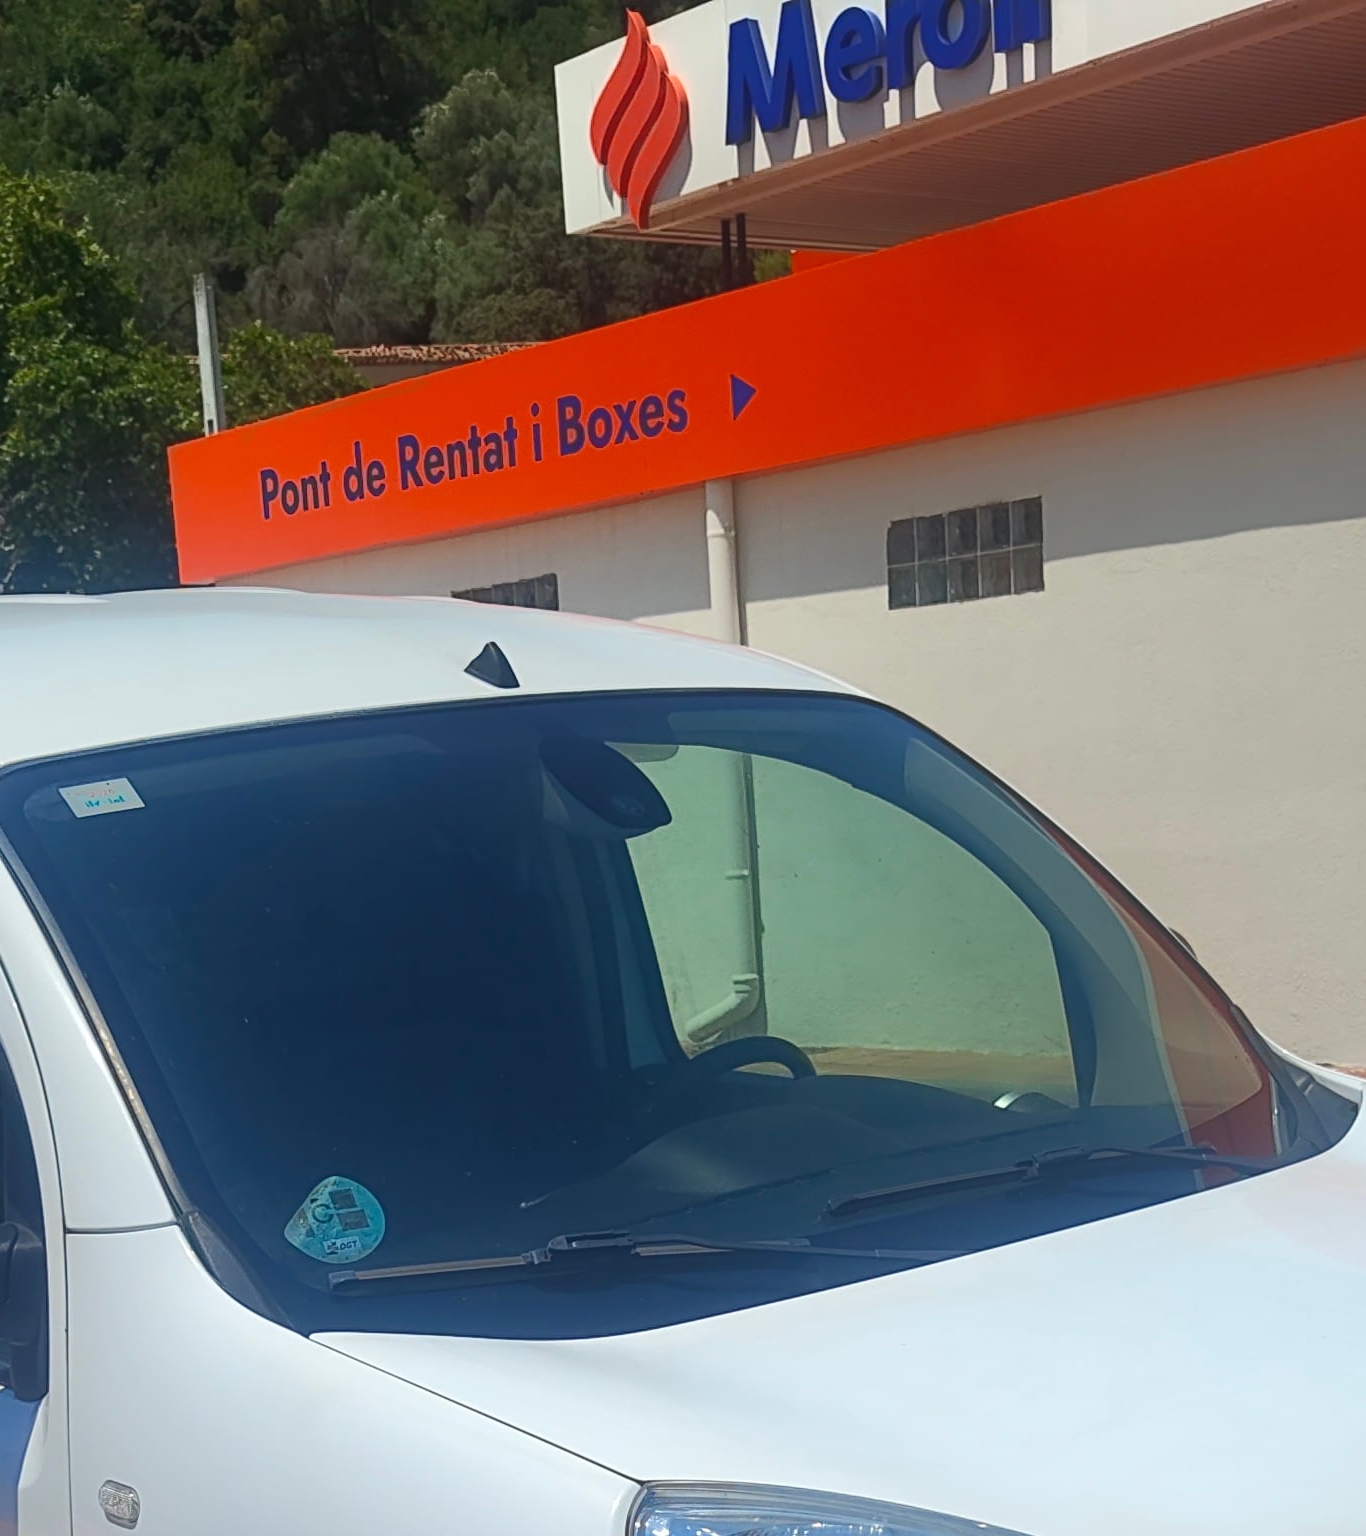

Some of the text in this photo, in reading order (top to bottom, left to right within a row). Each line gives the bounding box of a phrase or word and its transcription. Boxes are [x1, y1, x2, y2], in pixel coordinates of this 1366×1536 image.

[260, 388, 688, 520] Pont de Rentat i Boxes
